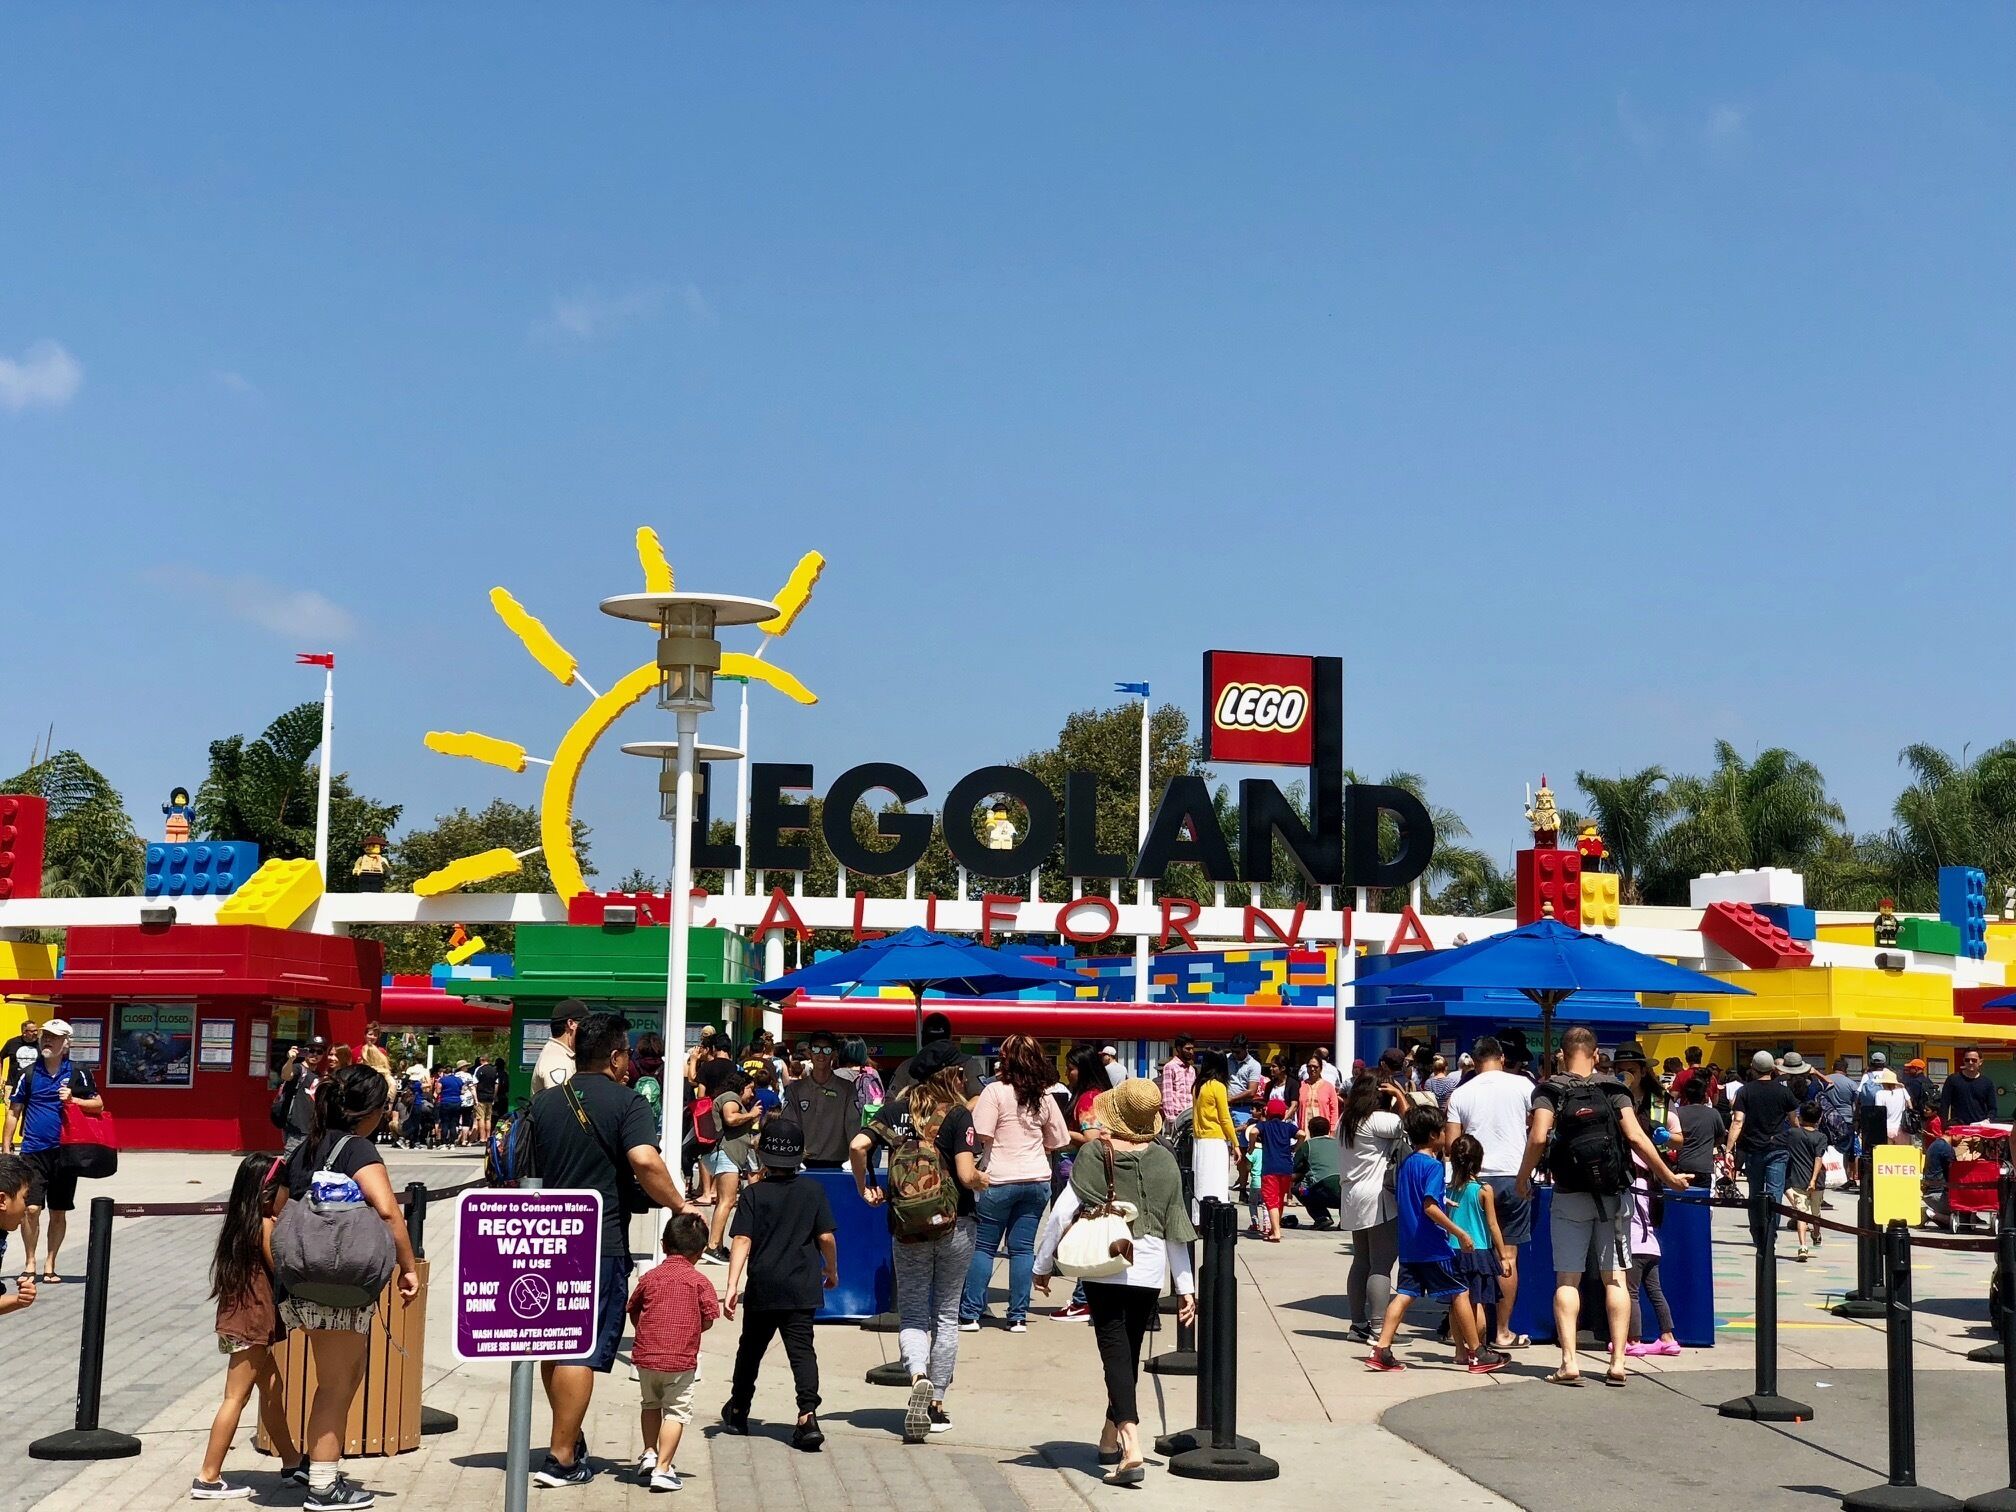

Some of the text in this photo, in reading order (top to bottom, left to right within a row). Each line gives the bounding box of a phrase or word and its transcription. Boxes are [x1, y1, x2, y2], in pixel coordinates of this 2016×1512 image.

[1218, 686, 1306, 730] LEGO
[691, 761, 1435, 888] LEGOLAND
[1877, 1164, 1917, 1176] ENTER
[468, 1202, 478, 1212] In
[480, 1202, 508, 1212] Order
[509, 1202, 519, 1212] to
[521, 1202, 563, 1212] Conserve
[478, 1218, 584, 1236] RECYCLED
[496, 1237, 567, 1255] WATER
[512, 1259, 552, 1269] IN USE
[463, 1281, 500, 1296] DO NOT
[556, 1280, 592, 1294] NO TOME
[465, 1298, 497, 1313] DRINK
[556, 1297, 590, 1311] EL AGUA
[471, 1326, 583, 1339] WASH HANDS AFTER CONTACTING
